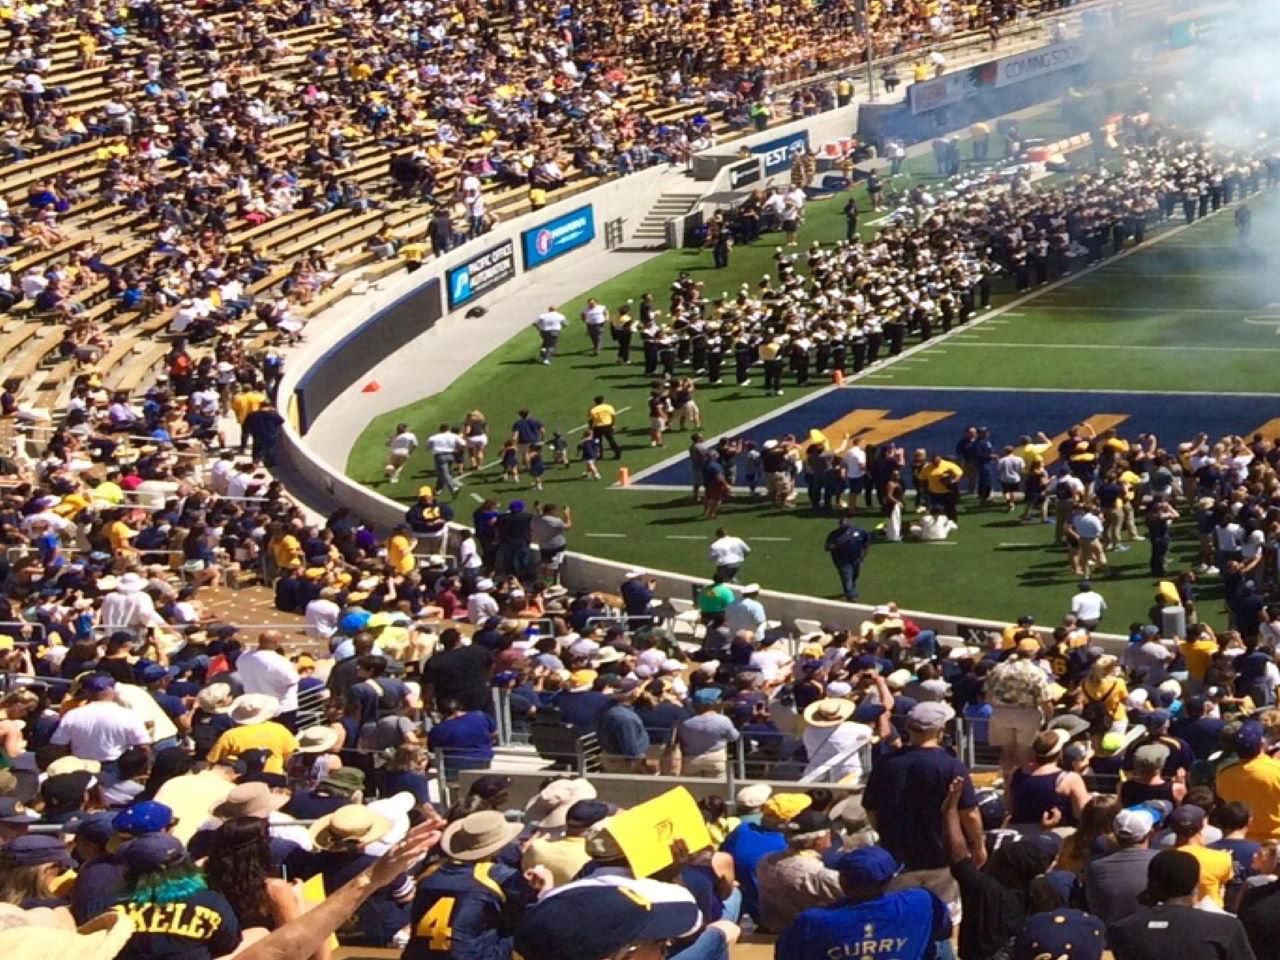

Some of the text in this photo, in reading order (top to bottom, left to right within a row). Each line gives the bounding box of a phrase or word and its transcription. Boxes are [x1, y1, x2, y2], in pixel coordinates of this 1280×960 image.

[1005, 54, 1049, 79] COMING
[128, 901, 222, 939] KELEY
[416, 896, 456, 950] 4
[827, 937, 909, 959] CURRY
